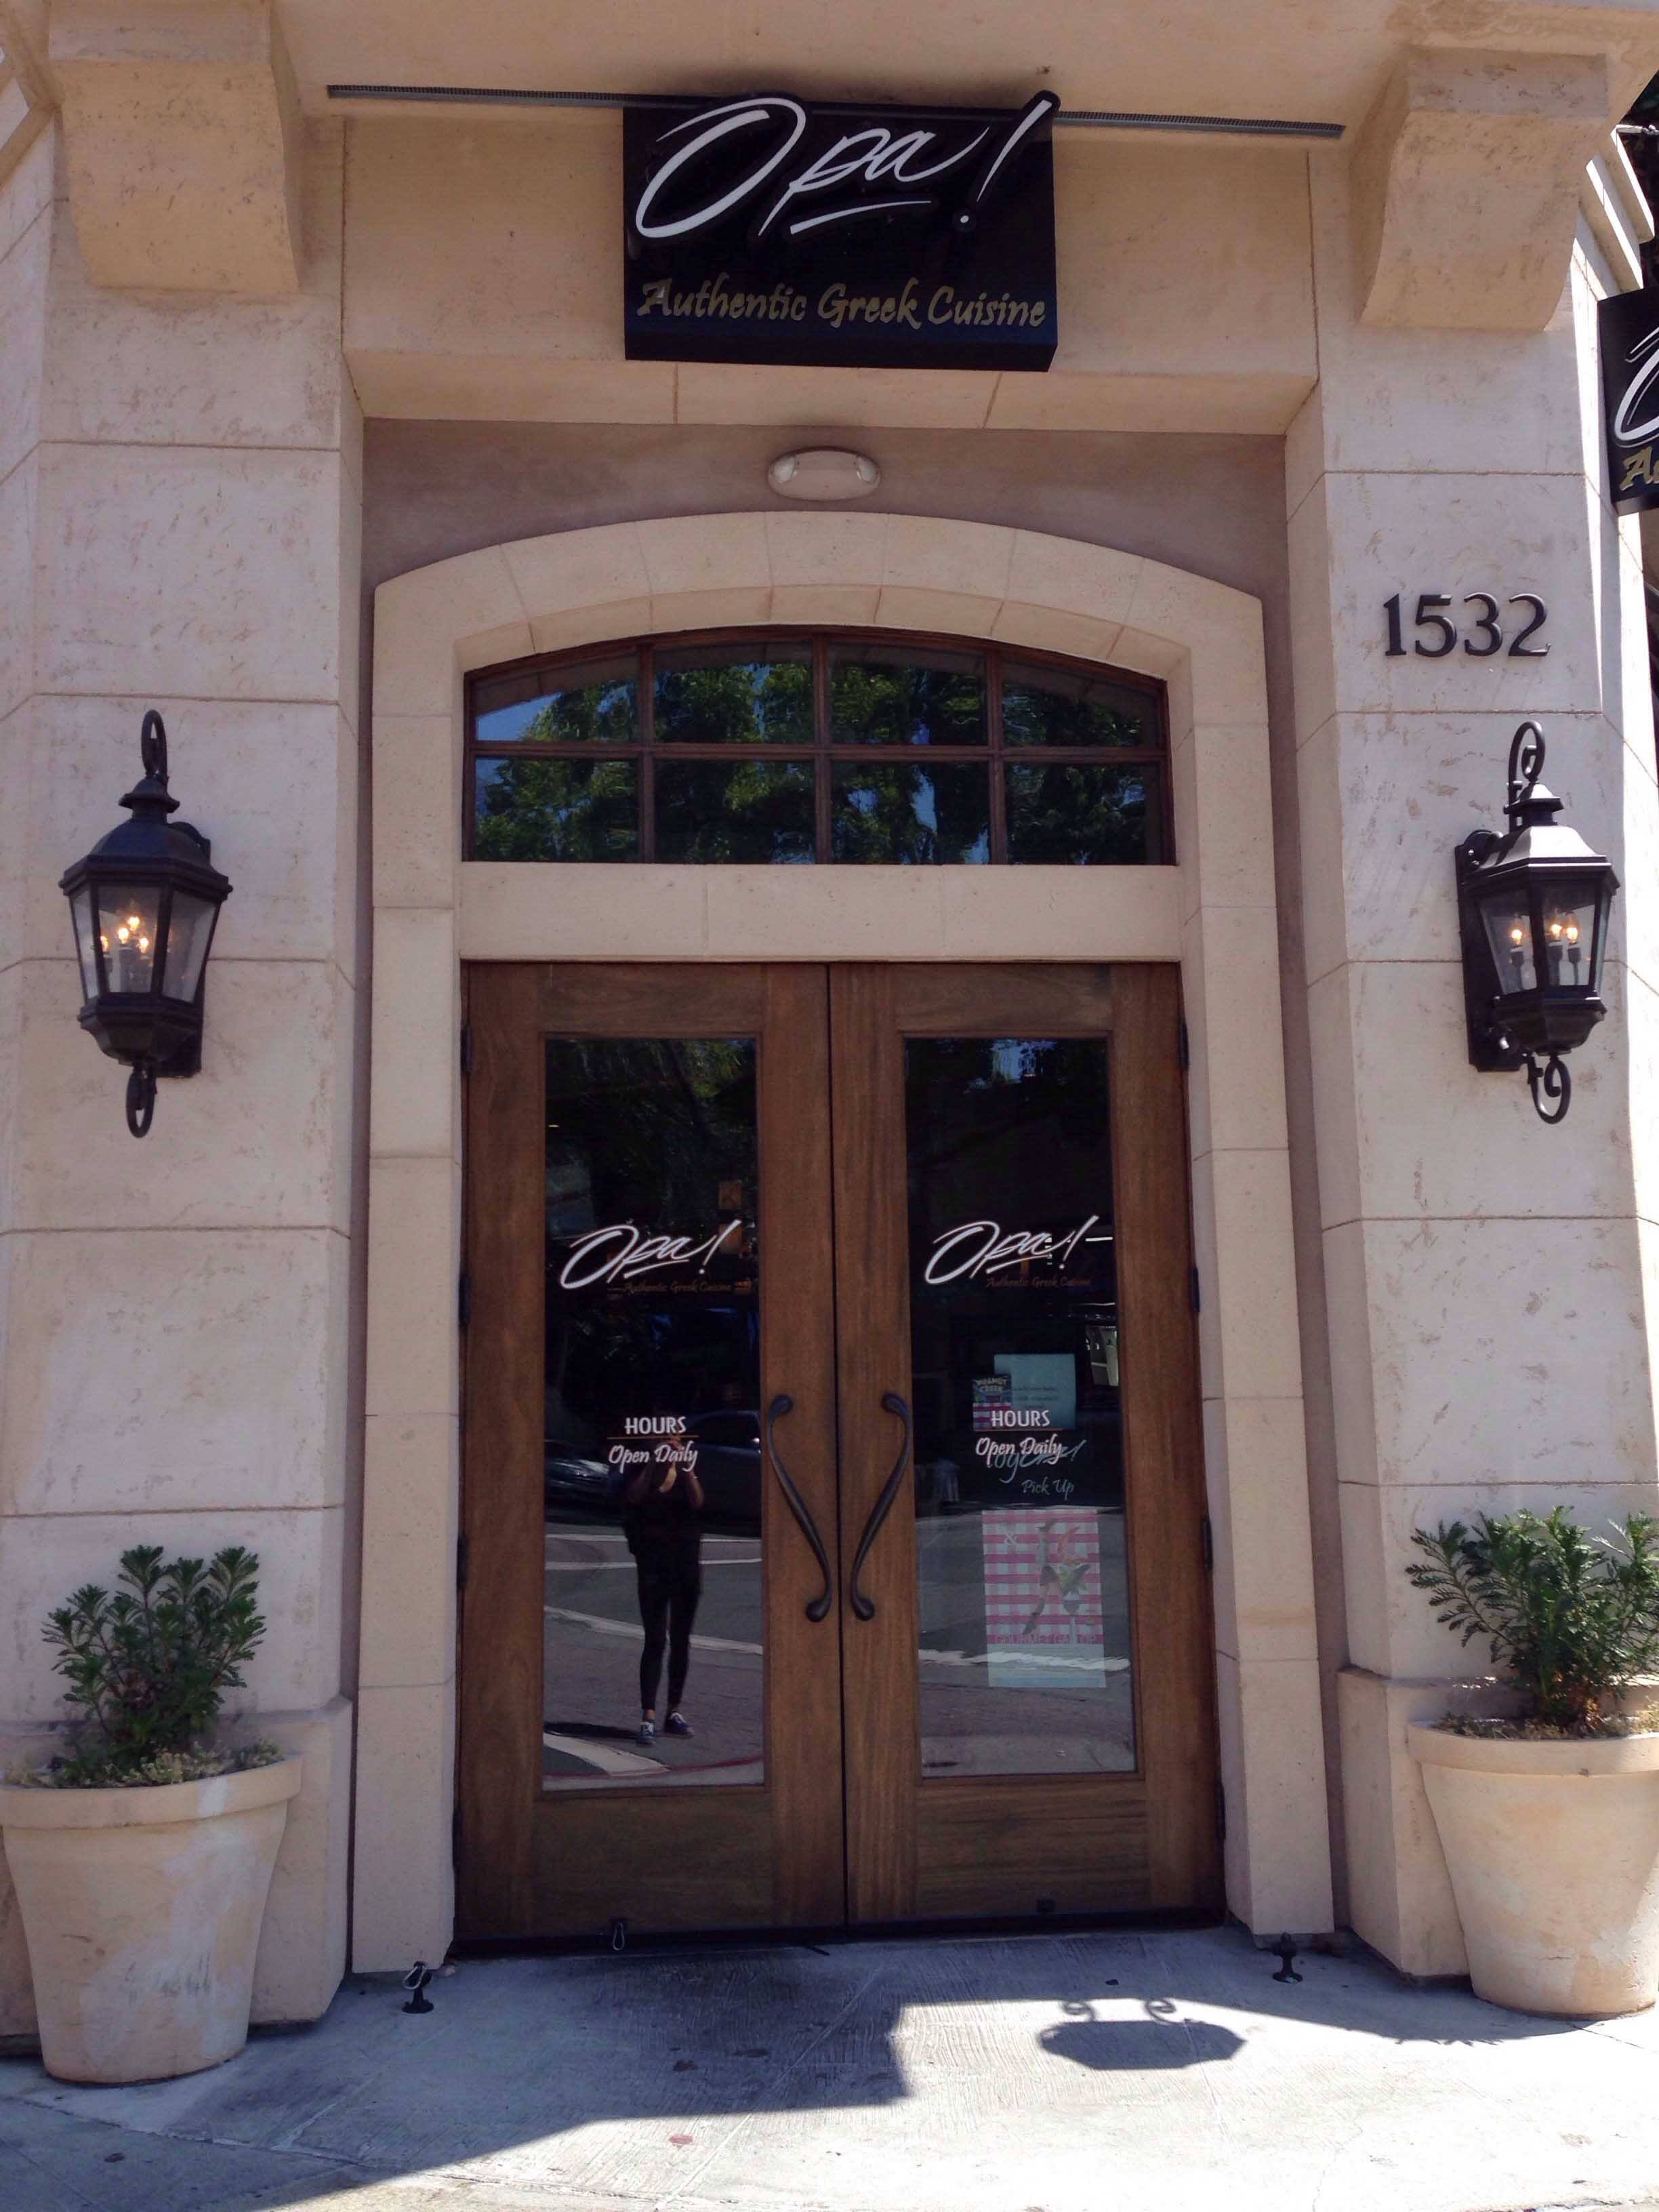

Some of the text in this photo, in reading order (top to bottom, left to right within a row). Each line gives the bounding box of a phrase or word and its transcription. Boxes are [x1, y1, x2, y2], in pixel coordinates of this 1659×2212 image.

[636, 97, 1052, 239] Opa!
[637, 272, 1046, 329] Authentic Greek Cuisine
[1383, 592, 1551, 657] 1532
[560, 1219, 742, 1290] Opa!
[924, 1214, 1100, 1285] Opa!
[624, 1416, 687, 1435] HOURS
[991, 1410, 1050, 1427] HOURS
[609, 1440, 698, 1474] Open Daily
[975, 1433, 1063, 1469] Open Daily
[1021, 1477, 1074, 1500] Pick Up
